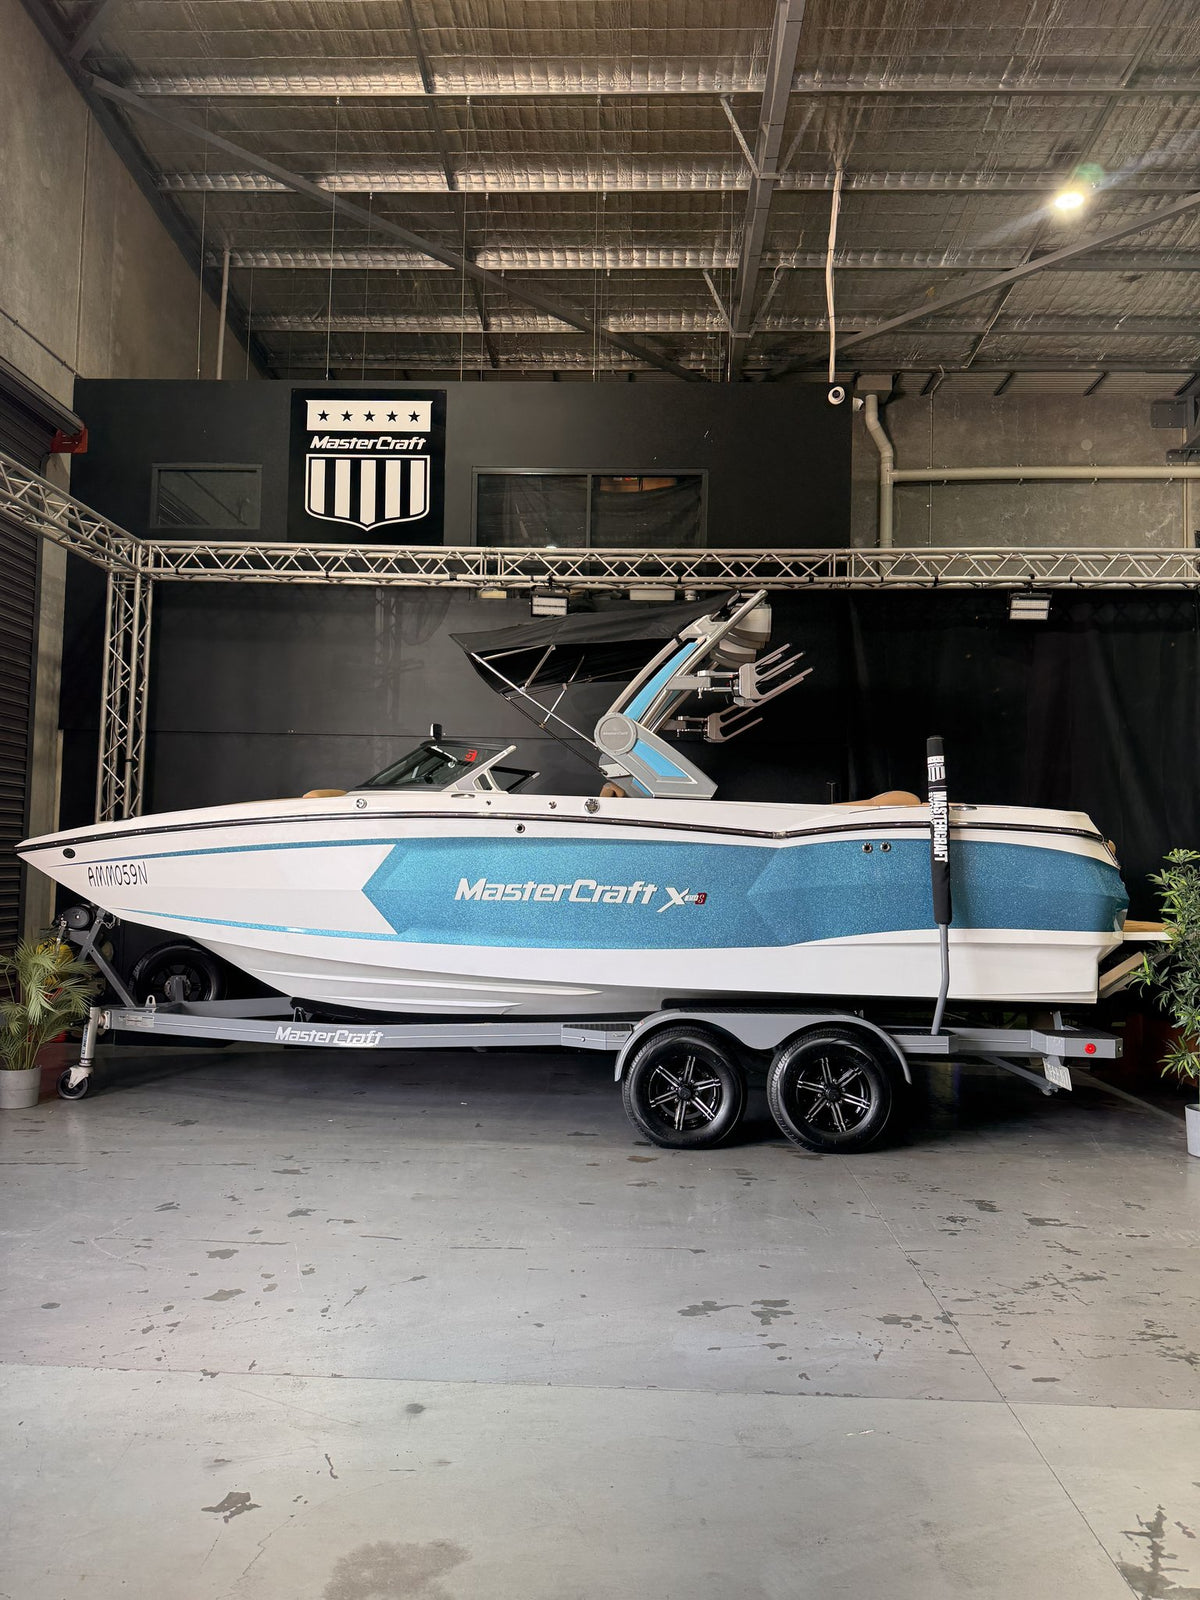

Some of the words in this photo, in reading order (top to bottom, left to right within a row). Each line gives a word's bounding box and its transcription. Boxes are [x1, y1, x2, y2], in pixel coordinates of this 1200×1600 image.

[310, 435, 427, 450] MasterCraft
[933, 790, 949, 863] MASTERCRAFT
[454, 878, 658, 905] MasterCraft
[275, 1026, 384, 1045] MasterCraft
